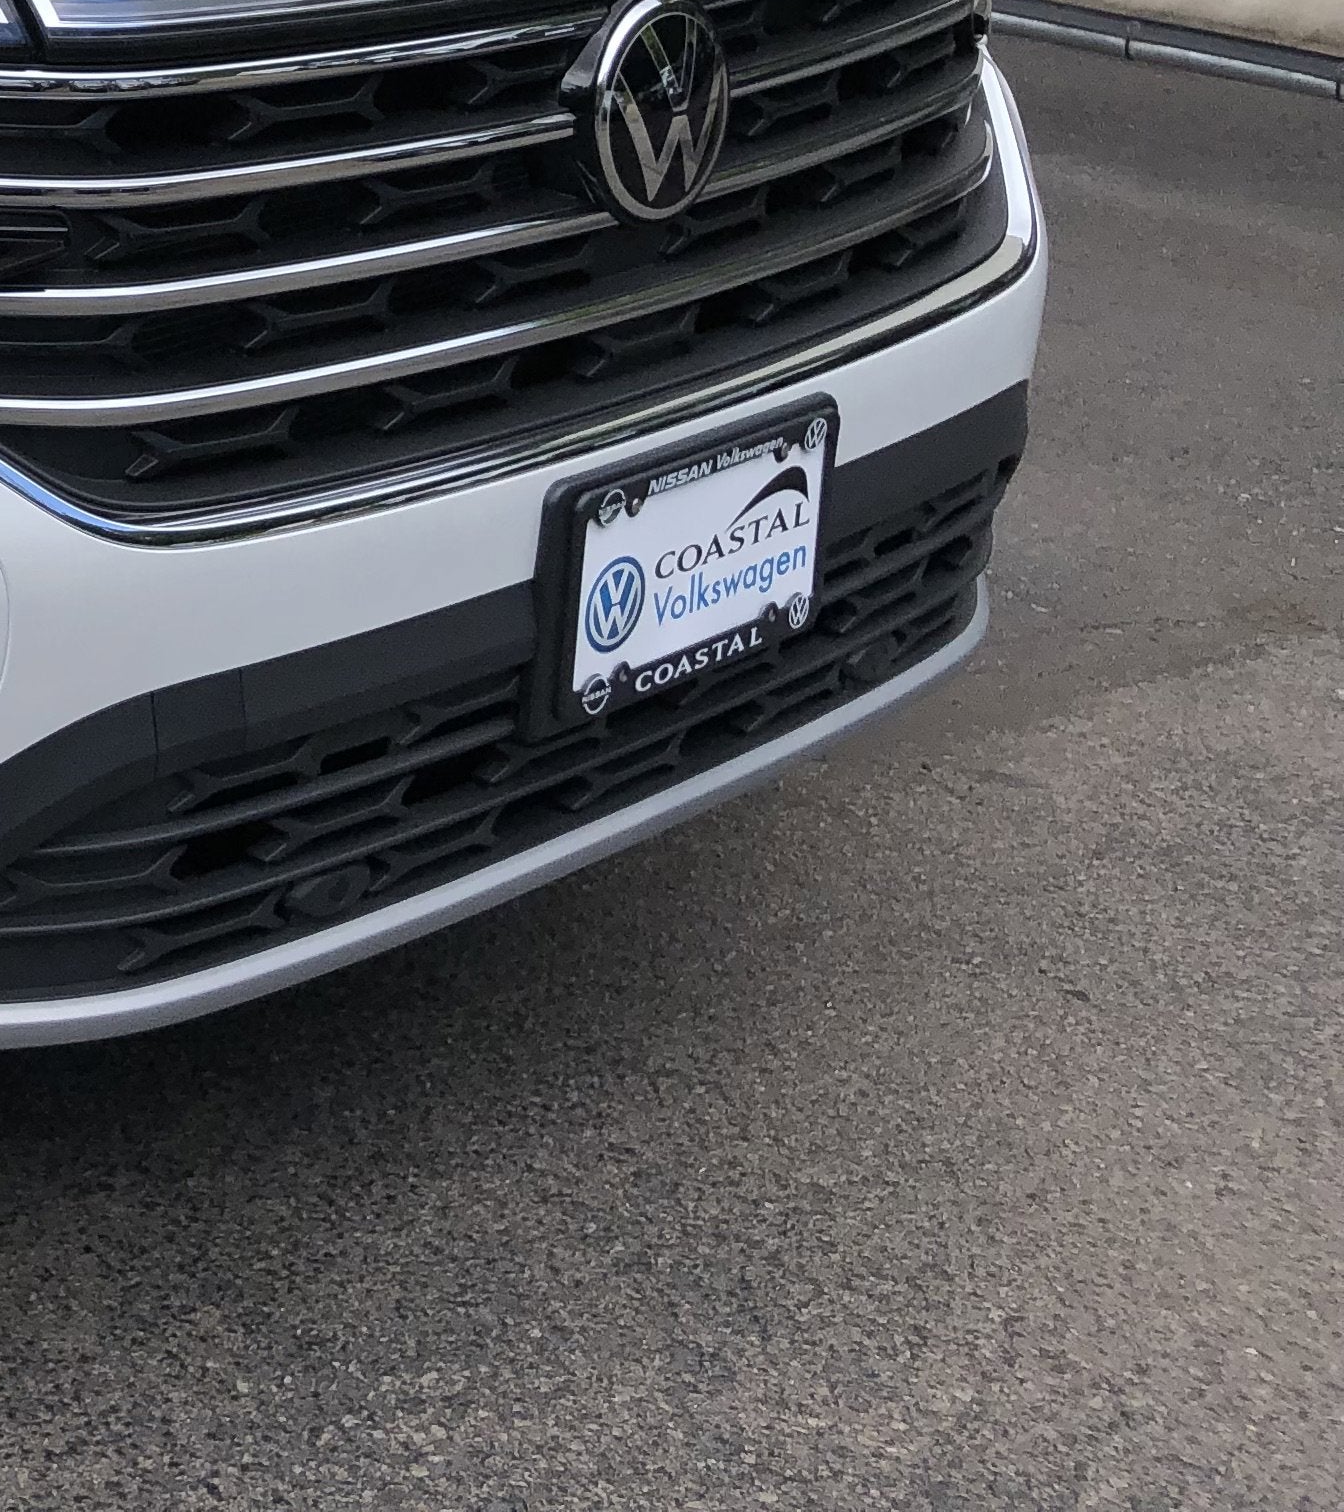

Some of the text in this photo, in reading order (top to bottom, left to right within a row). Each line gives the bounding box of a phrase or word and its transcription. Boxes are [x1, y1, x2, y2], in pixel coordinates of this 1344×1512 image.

[647, 437, 784, 497] NISSAN Volkswagen
[653, 502, 811, 580] COASTAL
[653, 544, 807, 626] Volkswagen
[634, 626, 763, 692] COASTAL
